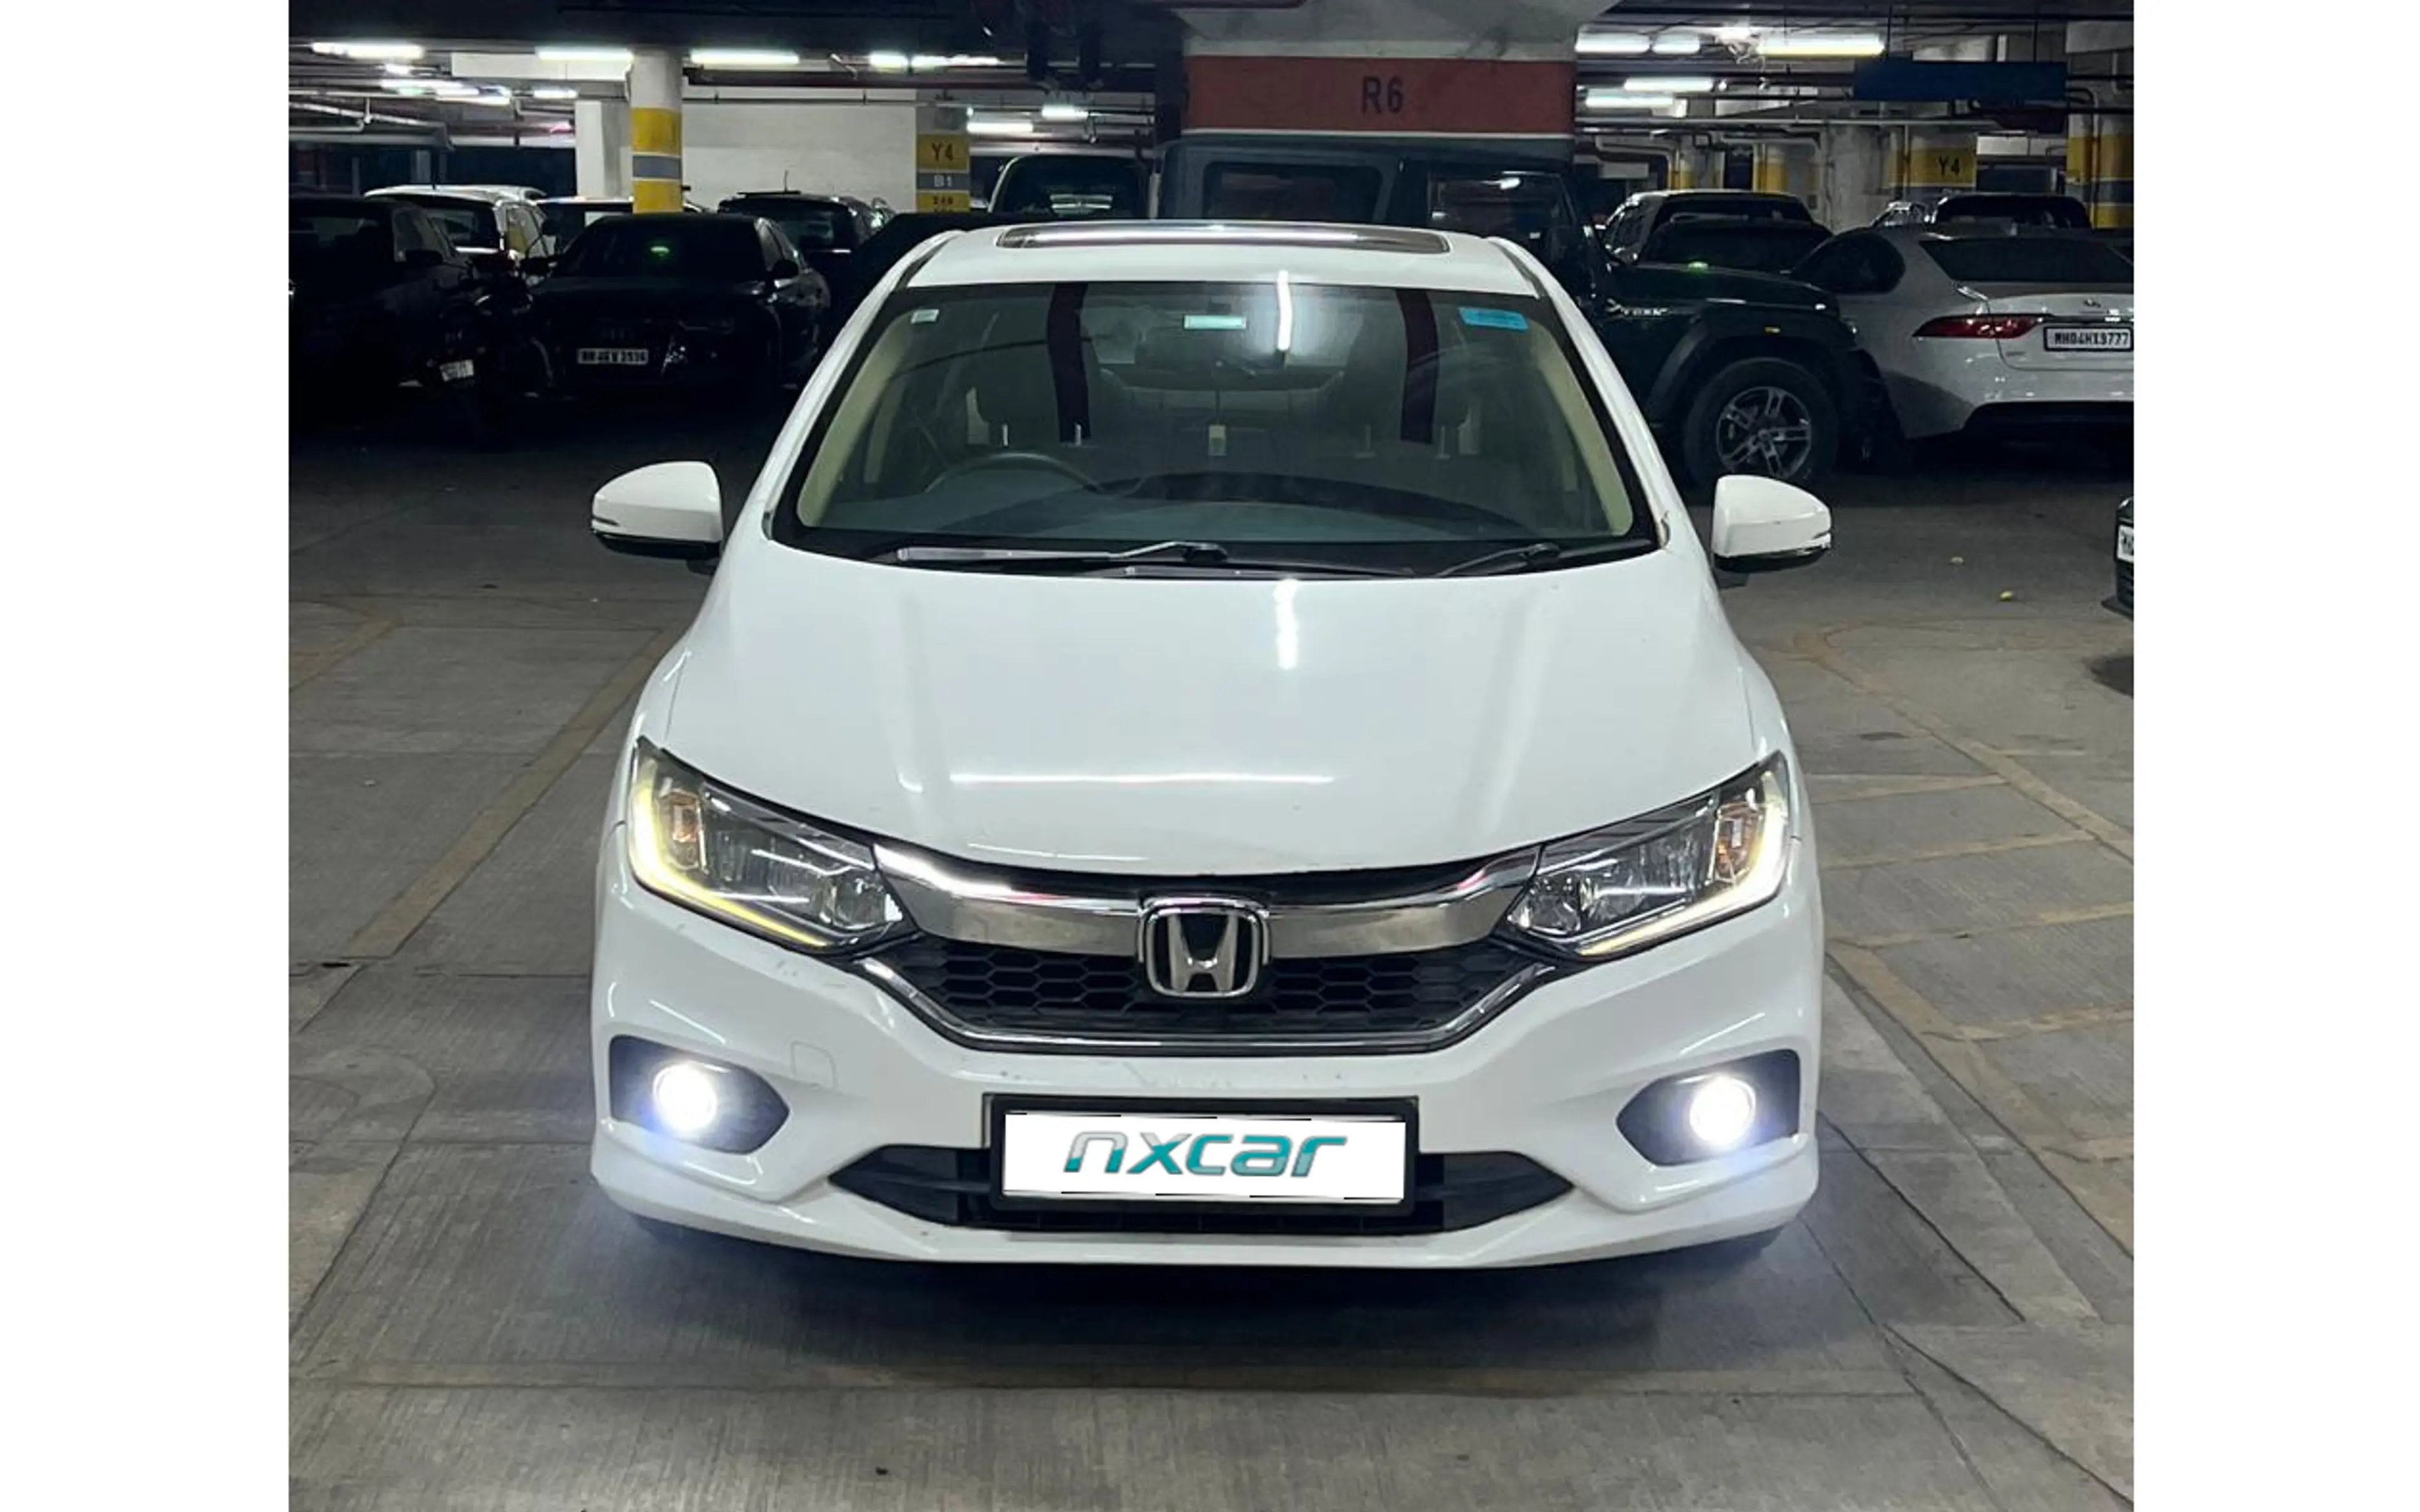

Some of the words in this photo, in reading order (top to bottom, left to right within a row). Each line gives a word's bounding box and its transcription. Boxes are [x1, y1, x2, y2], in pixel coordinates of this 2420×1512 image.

[1362, 75, 1404, 115] R6
[931, 142, 954, 162] Y4
[1939, 155, 1961, 176] Y4
